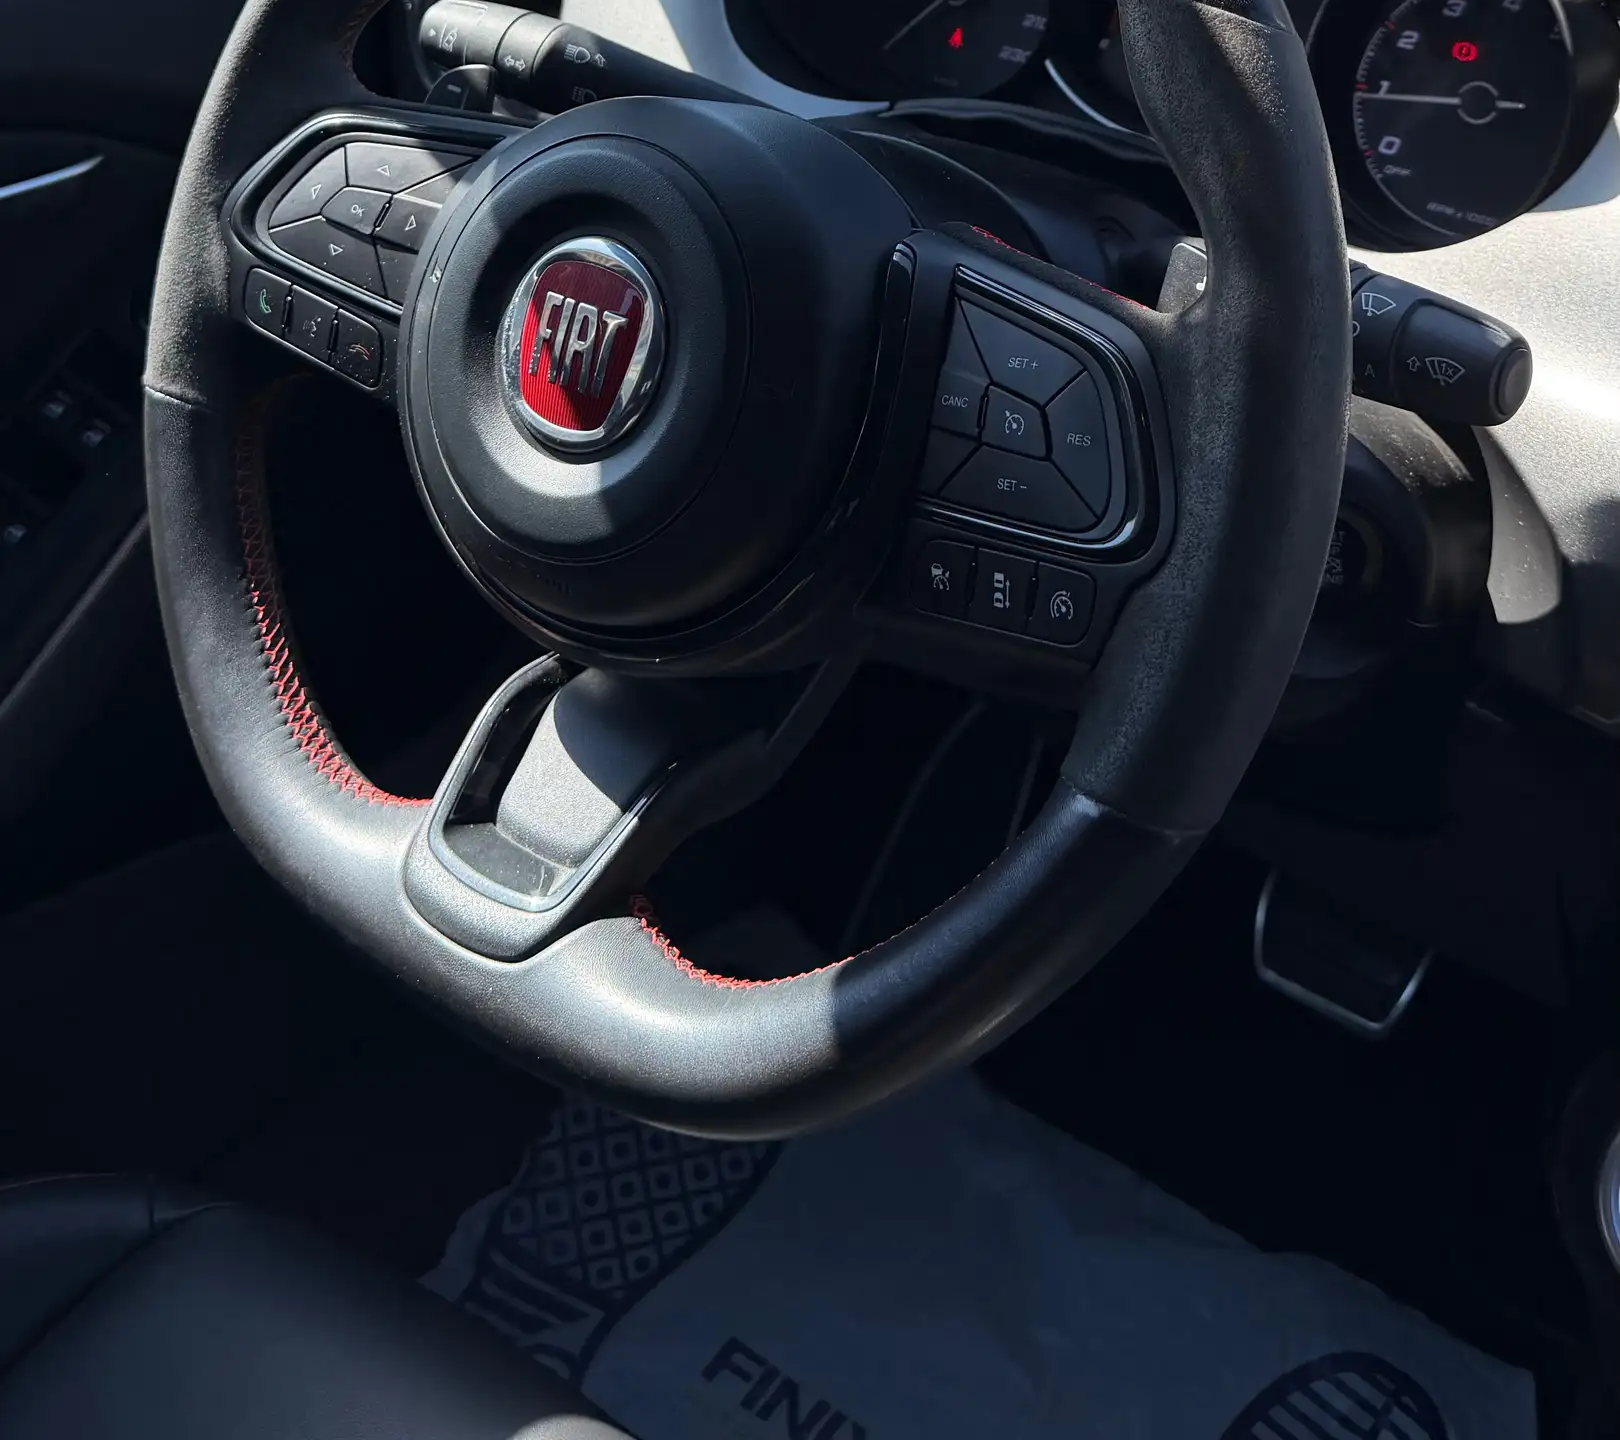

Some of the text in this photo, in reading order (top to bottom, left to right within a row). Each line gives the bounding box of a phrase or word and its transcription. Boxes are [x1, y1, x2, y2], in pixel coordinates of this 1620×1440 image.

[1396, 30, 1420, 50] 2
[1377, 80, 1391, 96] 1
[1377, 136, 1401, 155] 0
[350, 203, 366, 217] OK
[528, 289, 630, 399] FIAT
[1007, 356, 1029, 370] SET
[941, 394, 969, 409] CANC
[1066, 432, 1092, 447] RES
[997, 478, 1018, 492] SET
[701, 1336, 867, 1440] FINI
